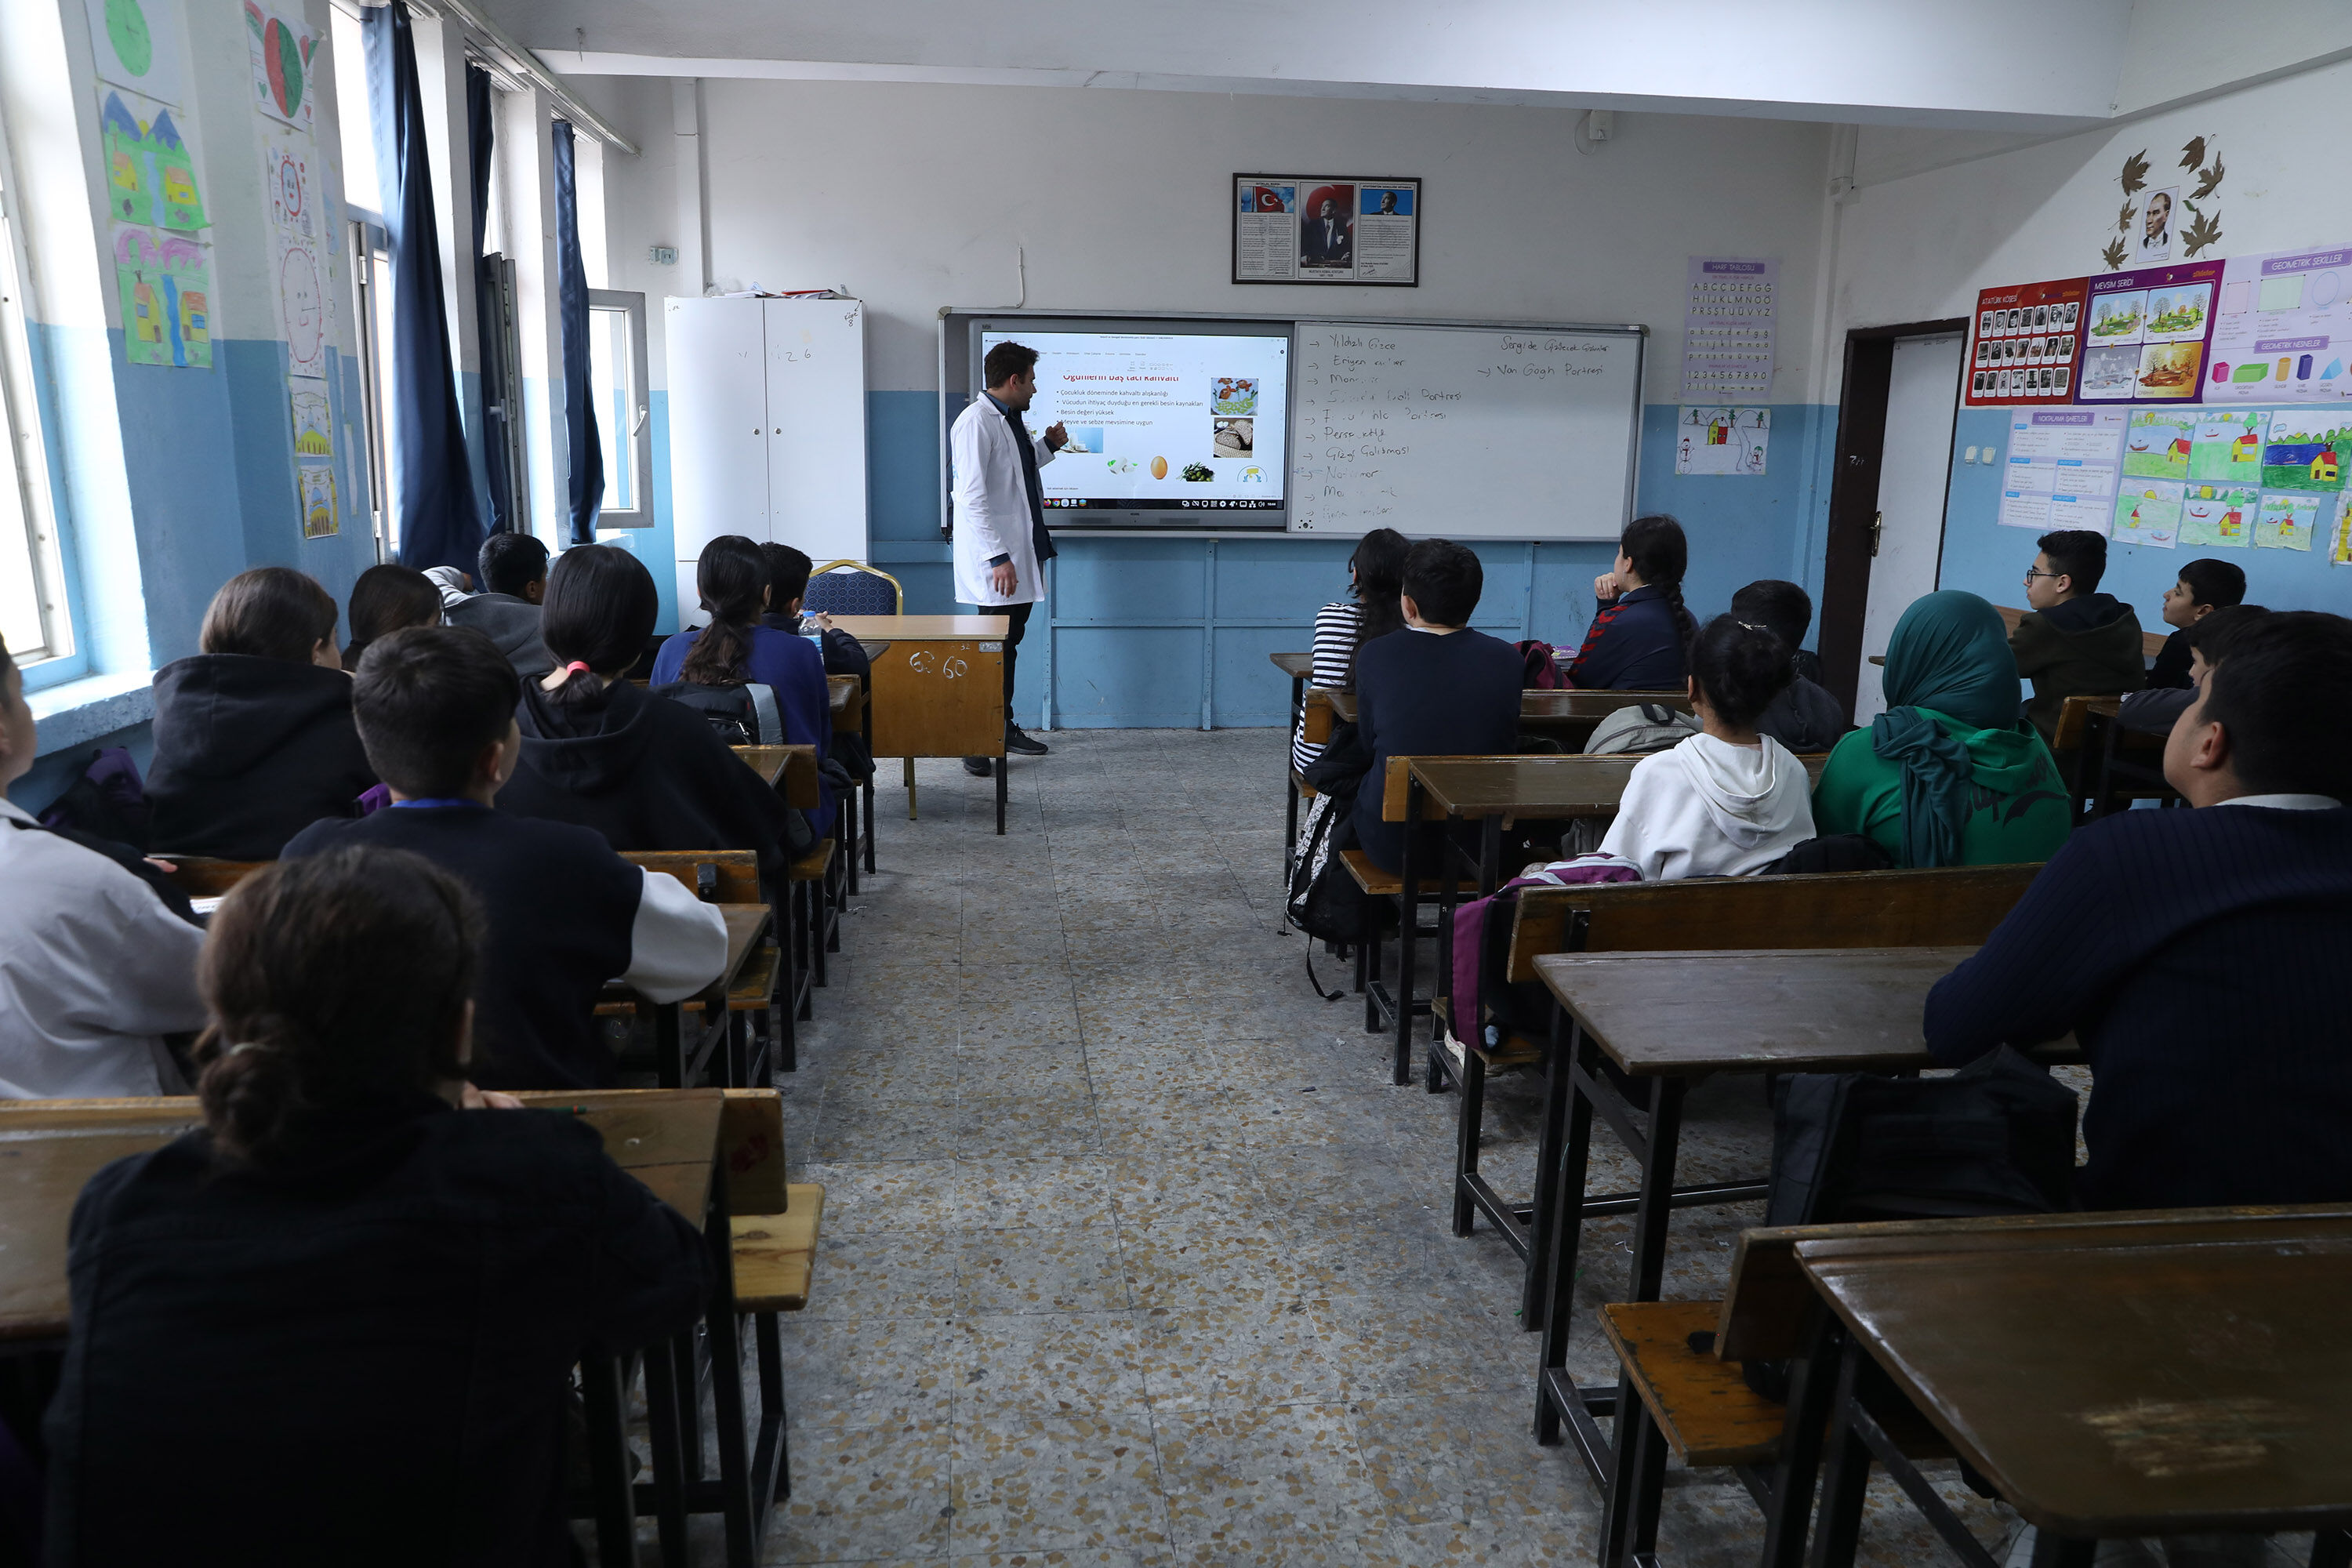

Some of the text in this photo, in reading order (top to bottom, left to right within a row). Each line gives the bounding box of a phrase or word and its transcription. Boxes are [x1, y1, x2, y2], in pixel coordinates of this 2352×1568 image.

[804, 349, 811, 358] 6
[1497, 365, 1517, 375] Van
[1523, 363, 1555, 379] Gogh
[943, 655, 968, 679] 60
